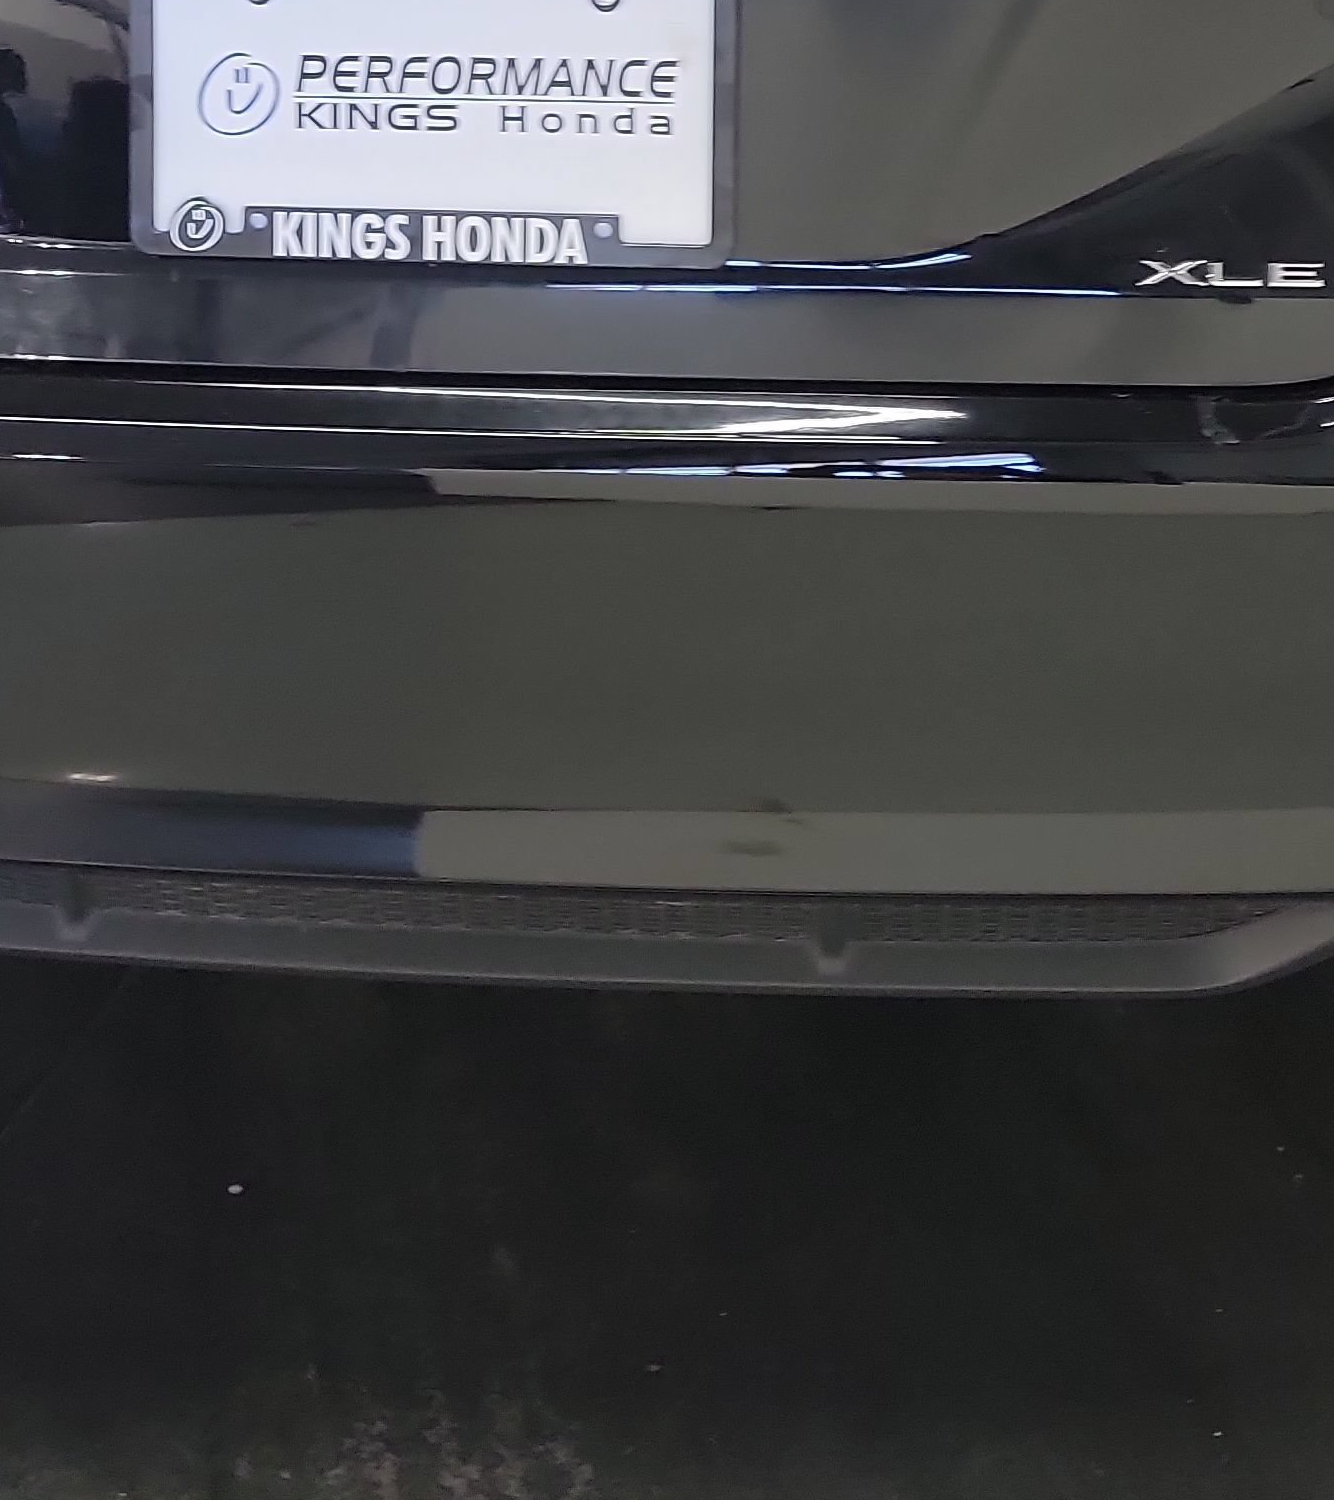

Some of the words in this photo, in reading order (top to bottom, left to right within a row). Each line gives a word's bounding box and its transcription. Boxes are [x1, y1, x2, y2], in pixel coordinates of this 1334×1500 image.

[296, 54, 679, 98] PERFORMANCE
[296, 103, 458, 132] KINGS
[500, 106, 673, 135] Honda
[272, 211, 410, 260] KINGS
[422, 215, 588, 265] HONDA
[1134, 260, 1326, 287] XLE
